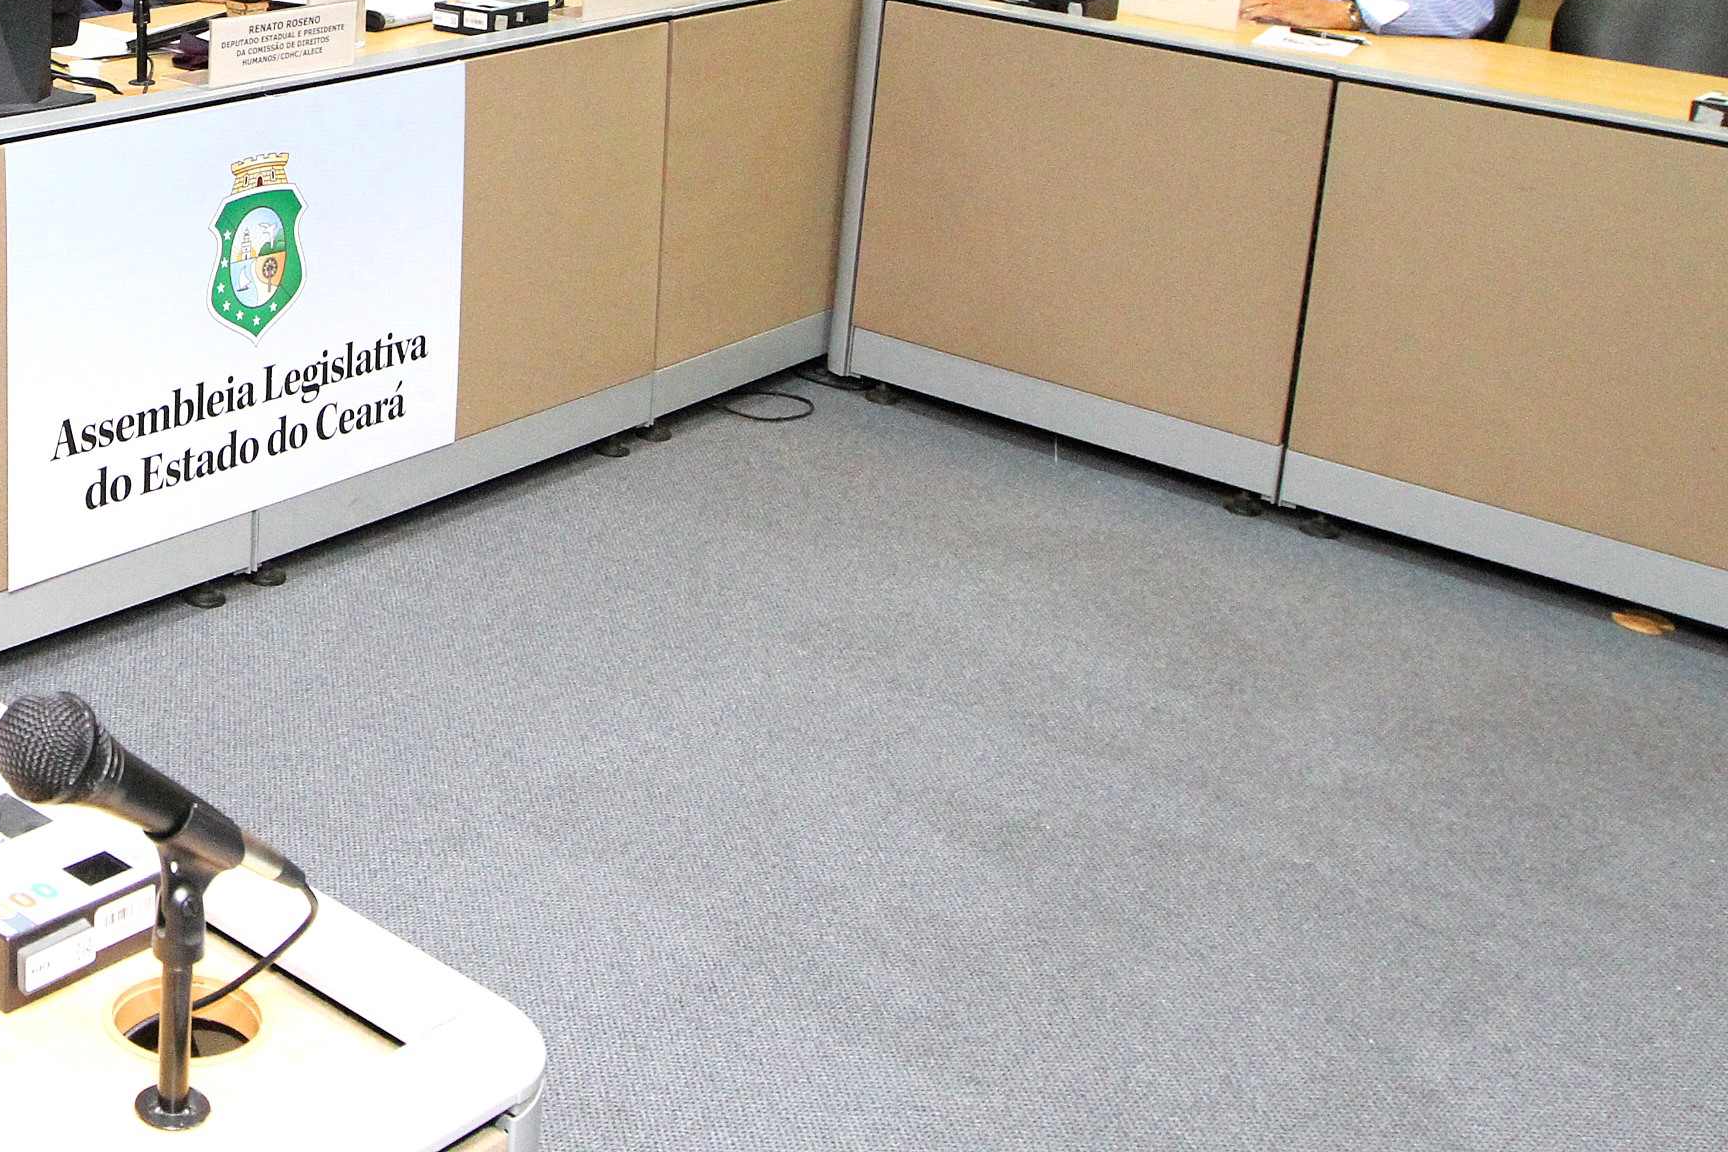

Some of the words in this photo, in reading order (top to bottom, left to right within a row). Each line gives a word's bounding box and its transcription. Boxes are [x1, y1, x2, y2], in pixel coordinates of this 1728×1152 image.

[221, 37, 259, 49] DEPUTADO
[261, 32, 295, 43] ESTADUAL
[304, 23, 345, 36] PRESIDENTE
[248, 21, 284, 34] RENATO
[286, 16, 321, 28] ROSENO
[242, 46, 323, 66] HUMANOS/CDHC/ALECE
[248, 42, 284, 54] COMISSÃO
[297, 36, 330, 47] DIREITOS
[50, 375, 257, 462] Assembleia
[262, 332, 429, 404] Legislativa
[85, 467, 132, 510] do
[140, 429, 260, 496] Estado
[267, 416, 308, 459] do
[316, 380, 406, 441] Ceará
